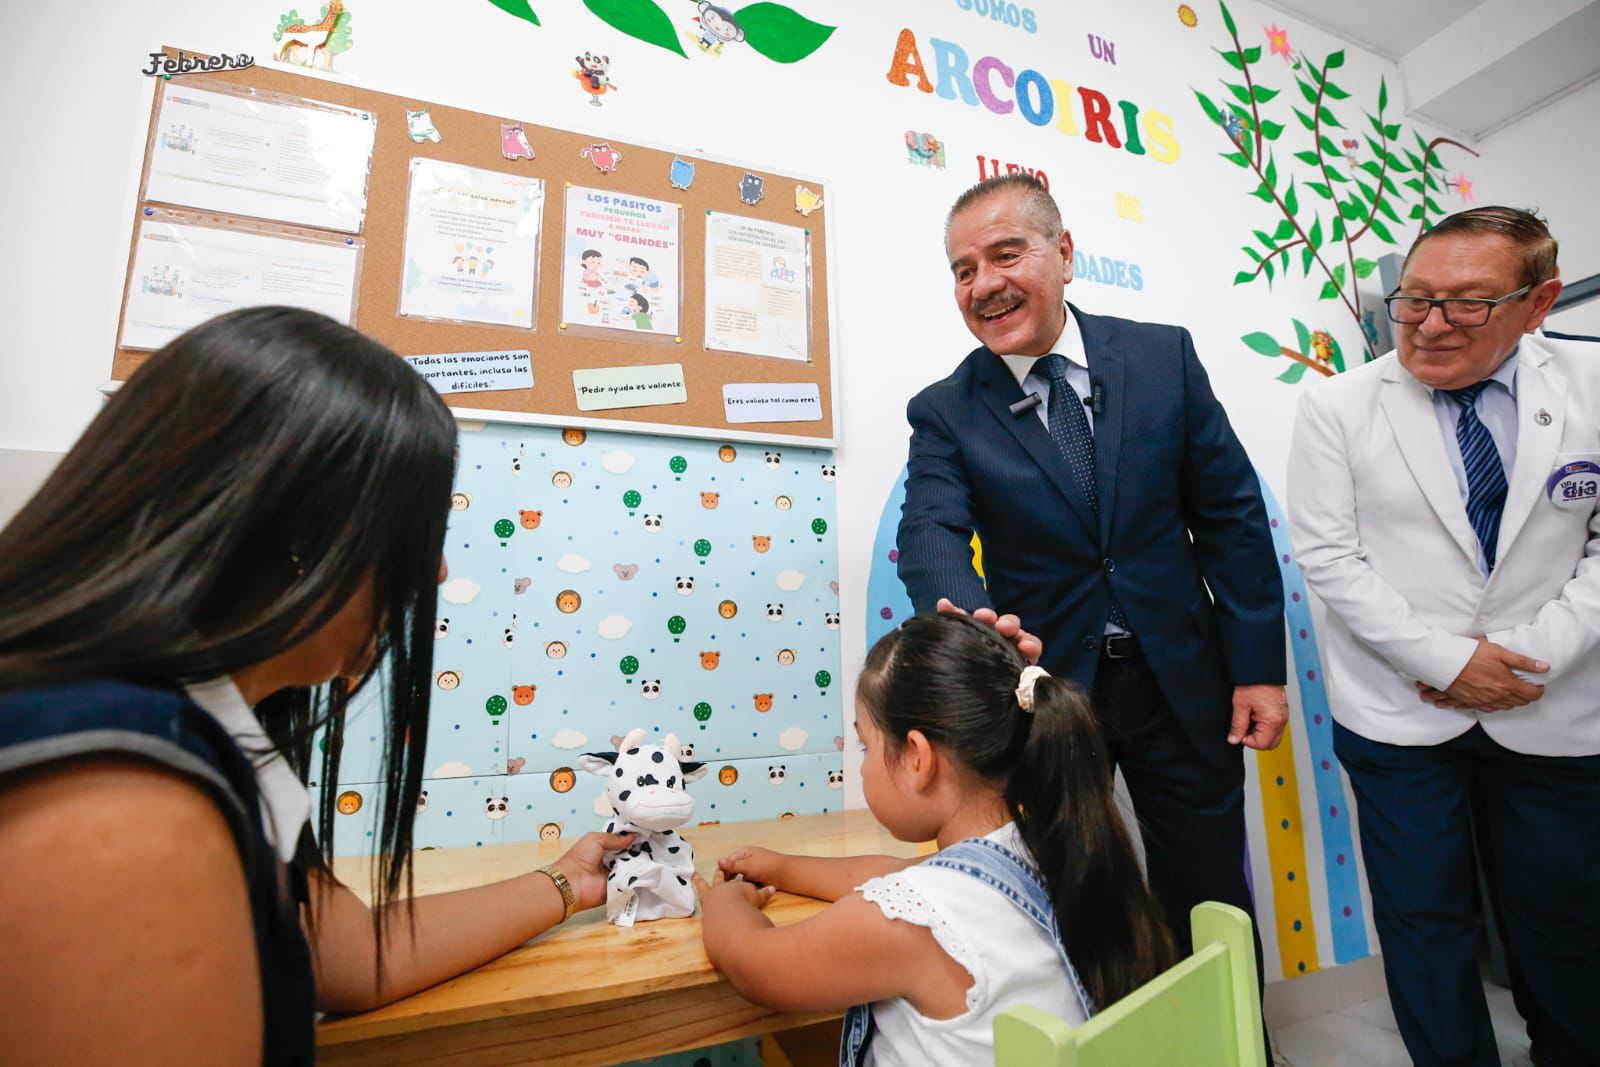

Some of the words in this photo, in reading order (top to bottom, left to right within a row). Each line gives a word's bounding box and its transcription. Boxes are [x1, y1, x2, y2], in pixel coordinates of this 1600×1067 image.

[1087, 33, 1117, 66] UN
[142, 51, 255, 75] Febrero
[886, 28, 1182, 165] ARCOIRIS
[587, 193, 610, 204] LOS
[612, 197, 662, 213] PASITOS
[1114, 191, 1144, 223] DE
[636, 219, 671, 231] LLEVAN
[576, 227, 605, 239] MUY
[608, 232, 675, 249] "GRANDES"
[1072, 250, 1144, 291] DADES
[408, 355, 441, 366] "Todas
[443, 355, 458, 364] las
[461, 353, 510, 363] emociones
[424, 368, 477, 379] portantes,
[479, 366, 512, 374] incluso
[514, 365, 528, 373] las
[608, 384, 634, 395] ayuda
[1562, 480, 1598, 499] día
